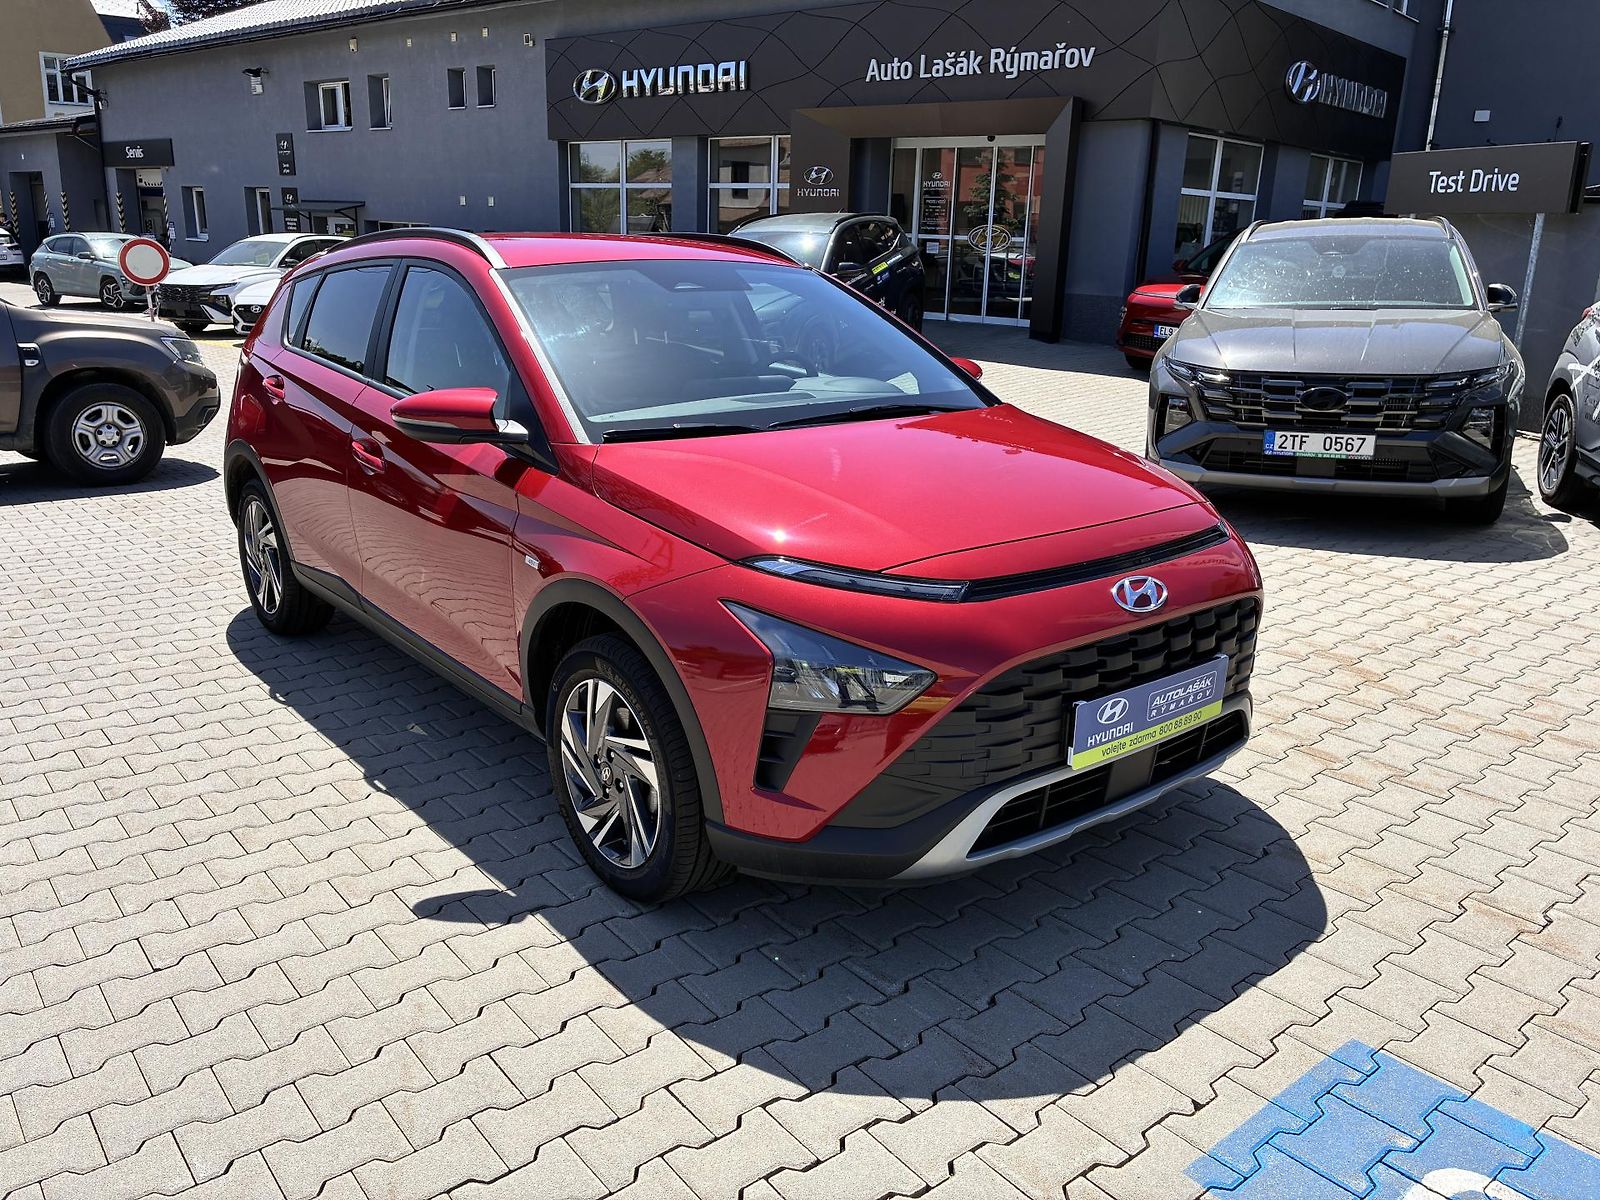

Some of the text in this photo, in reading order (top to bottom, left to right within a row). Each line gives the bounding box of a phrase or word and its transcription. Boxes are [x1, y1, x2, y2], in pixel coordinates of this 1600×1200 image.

[865, 42, 1096, 82] Auto Lašák Rýmařov
[622, 60, 746, 98] HYUNDAI
[1319, 72, 1387, 119] HYUNDAI
[125, 145, 144, 159] Servis
[796, 188, 840, 197] HYUNDAI
[923, 180, 951, 188] HYUNDAI
[1429, 167, 1520, 193] Test Drive
[1277, 433, 1367, 454] 2TF 0567
[1151, 676, 1213, 707] AUTOLAŠÁK
[1087, 721, 1134, 748] HYUNDAI
[1101, 740, 1127, 757] volejte
[1129, 730, 1157, 747] zdarma
[1158, 722, 1174, 735] 800
[1183, 714, 1193, 726] 89
[1192, 710, 1203, 722] 90
